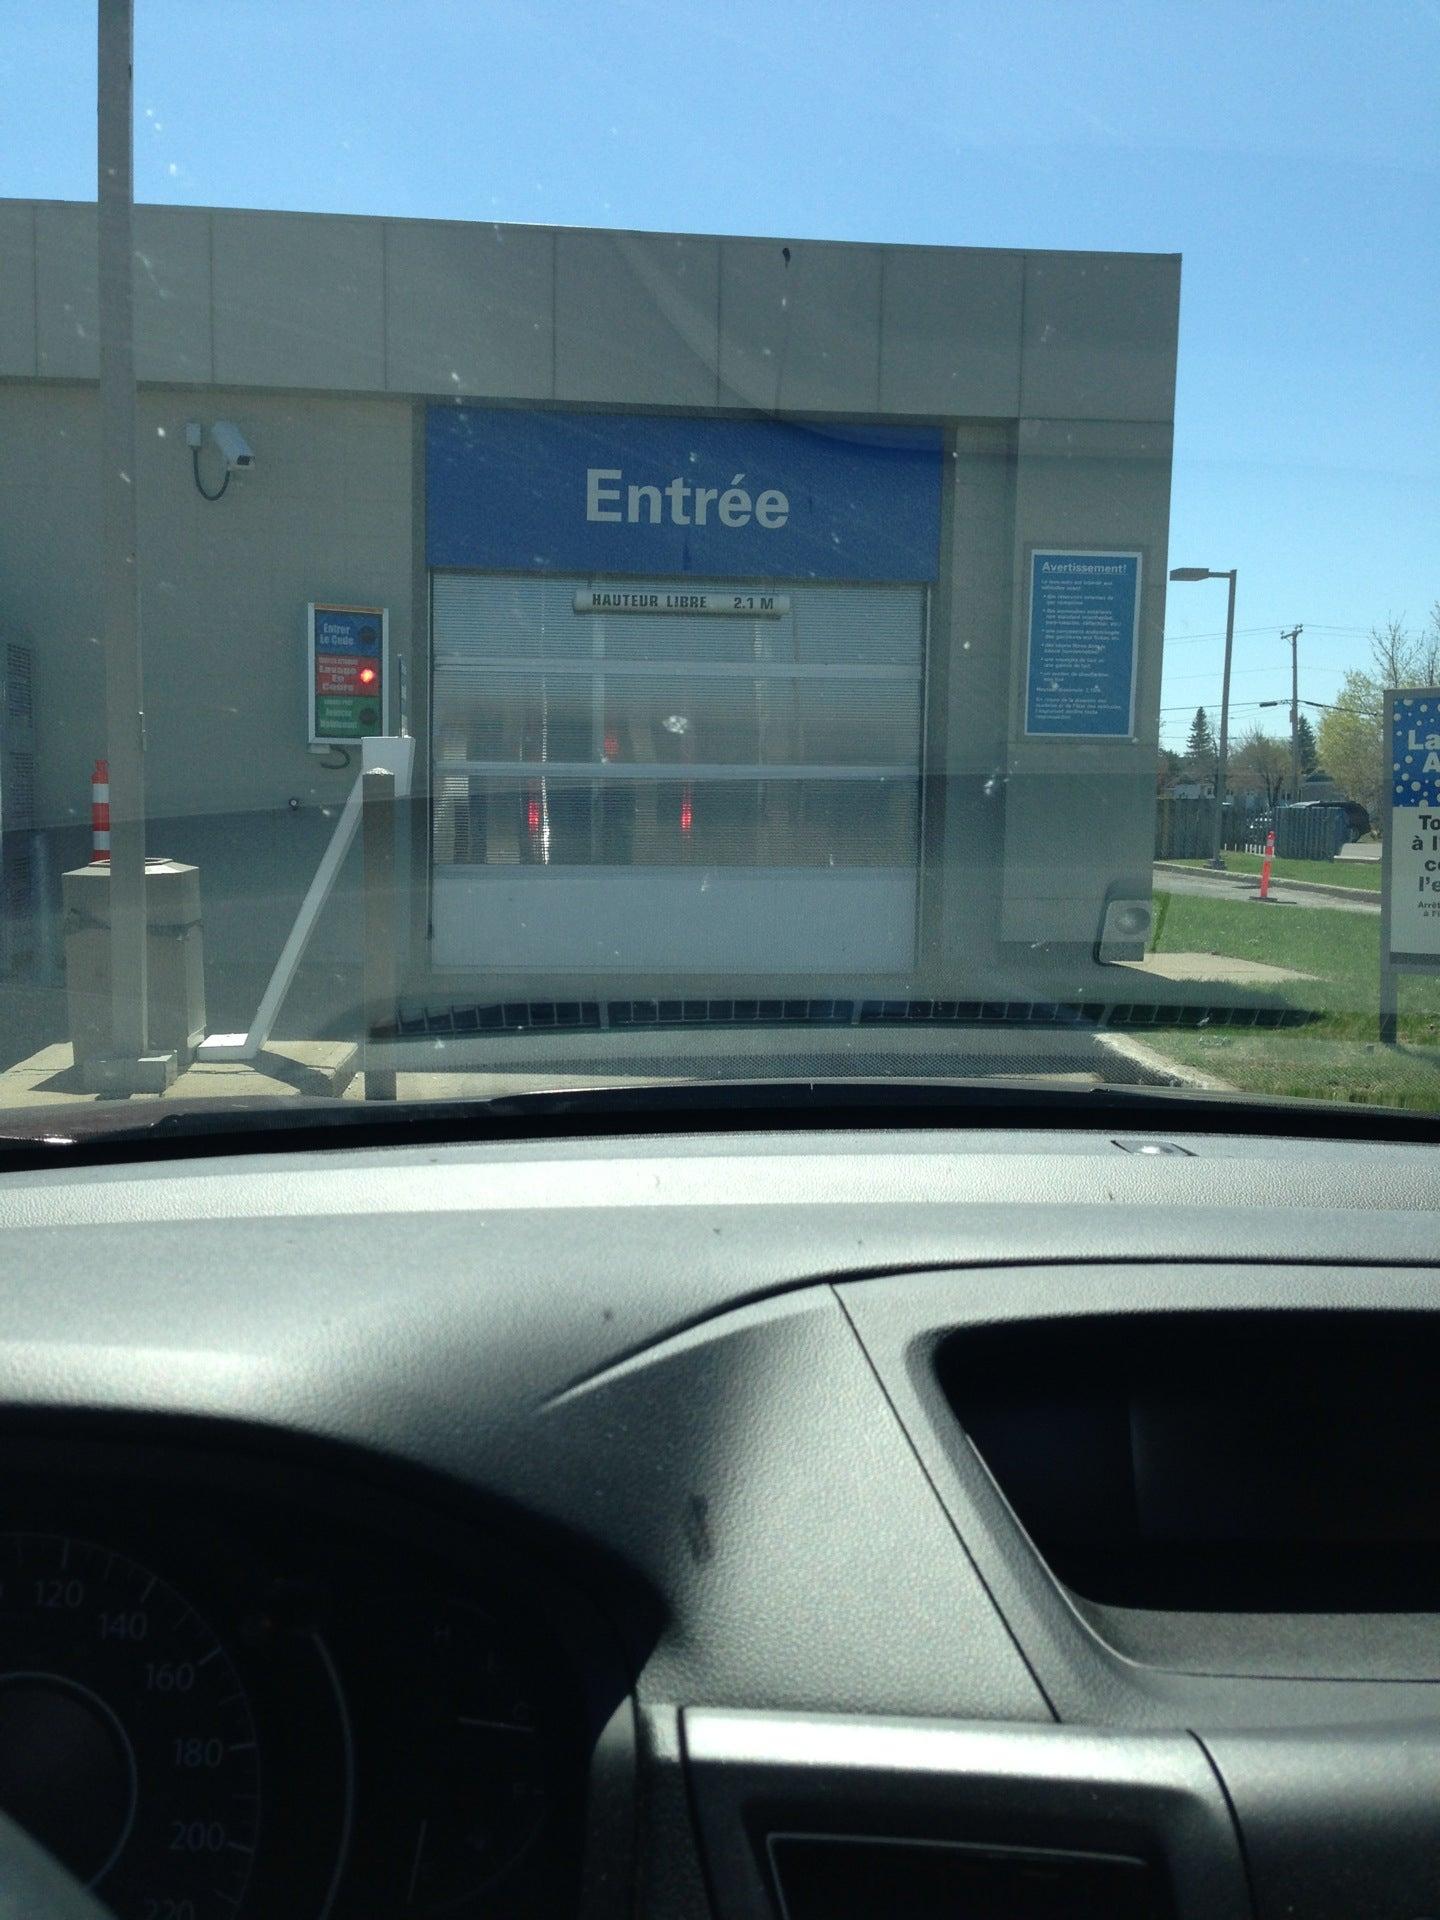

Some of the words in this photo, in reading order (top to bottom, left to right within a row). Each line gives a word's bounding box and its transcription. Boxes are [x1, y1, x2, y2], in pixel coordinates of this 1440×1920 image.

[586, 468, 790, 529] Entrée
[1041, 562, 1127, 574] Avertissement!
[592, 592, 659, 607] HAUTEUR
[666, 595, 707, 608] LIBRE
[733, 596, 754, 609] 2.1
[760, 597, 774, 610] M
[323, 623, 351, 634] Entrer
[1412, 835, 1423, 850] à
[34, 1580, 85, 1609] 120
[97, 1612, 149, 1641] 140
[145, 1663, 195, 1692] 160
[174, 1738, 224, 1768] 180
[168, 1821, 226, 1852] 200
